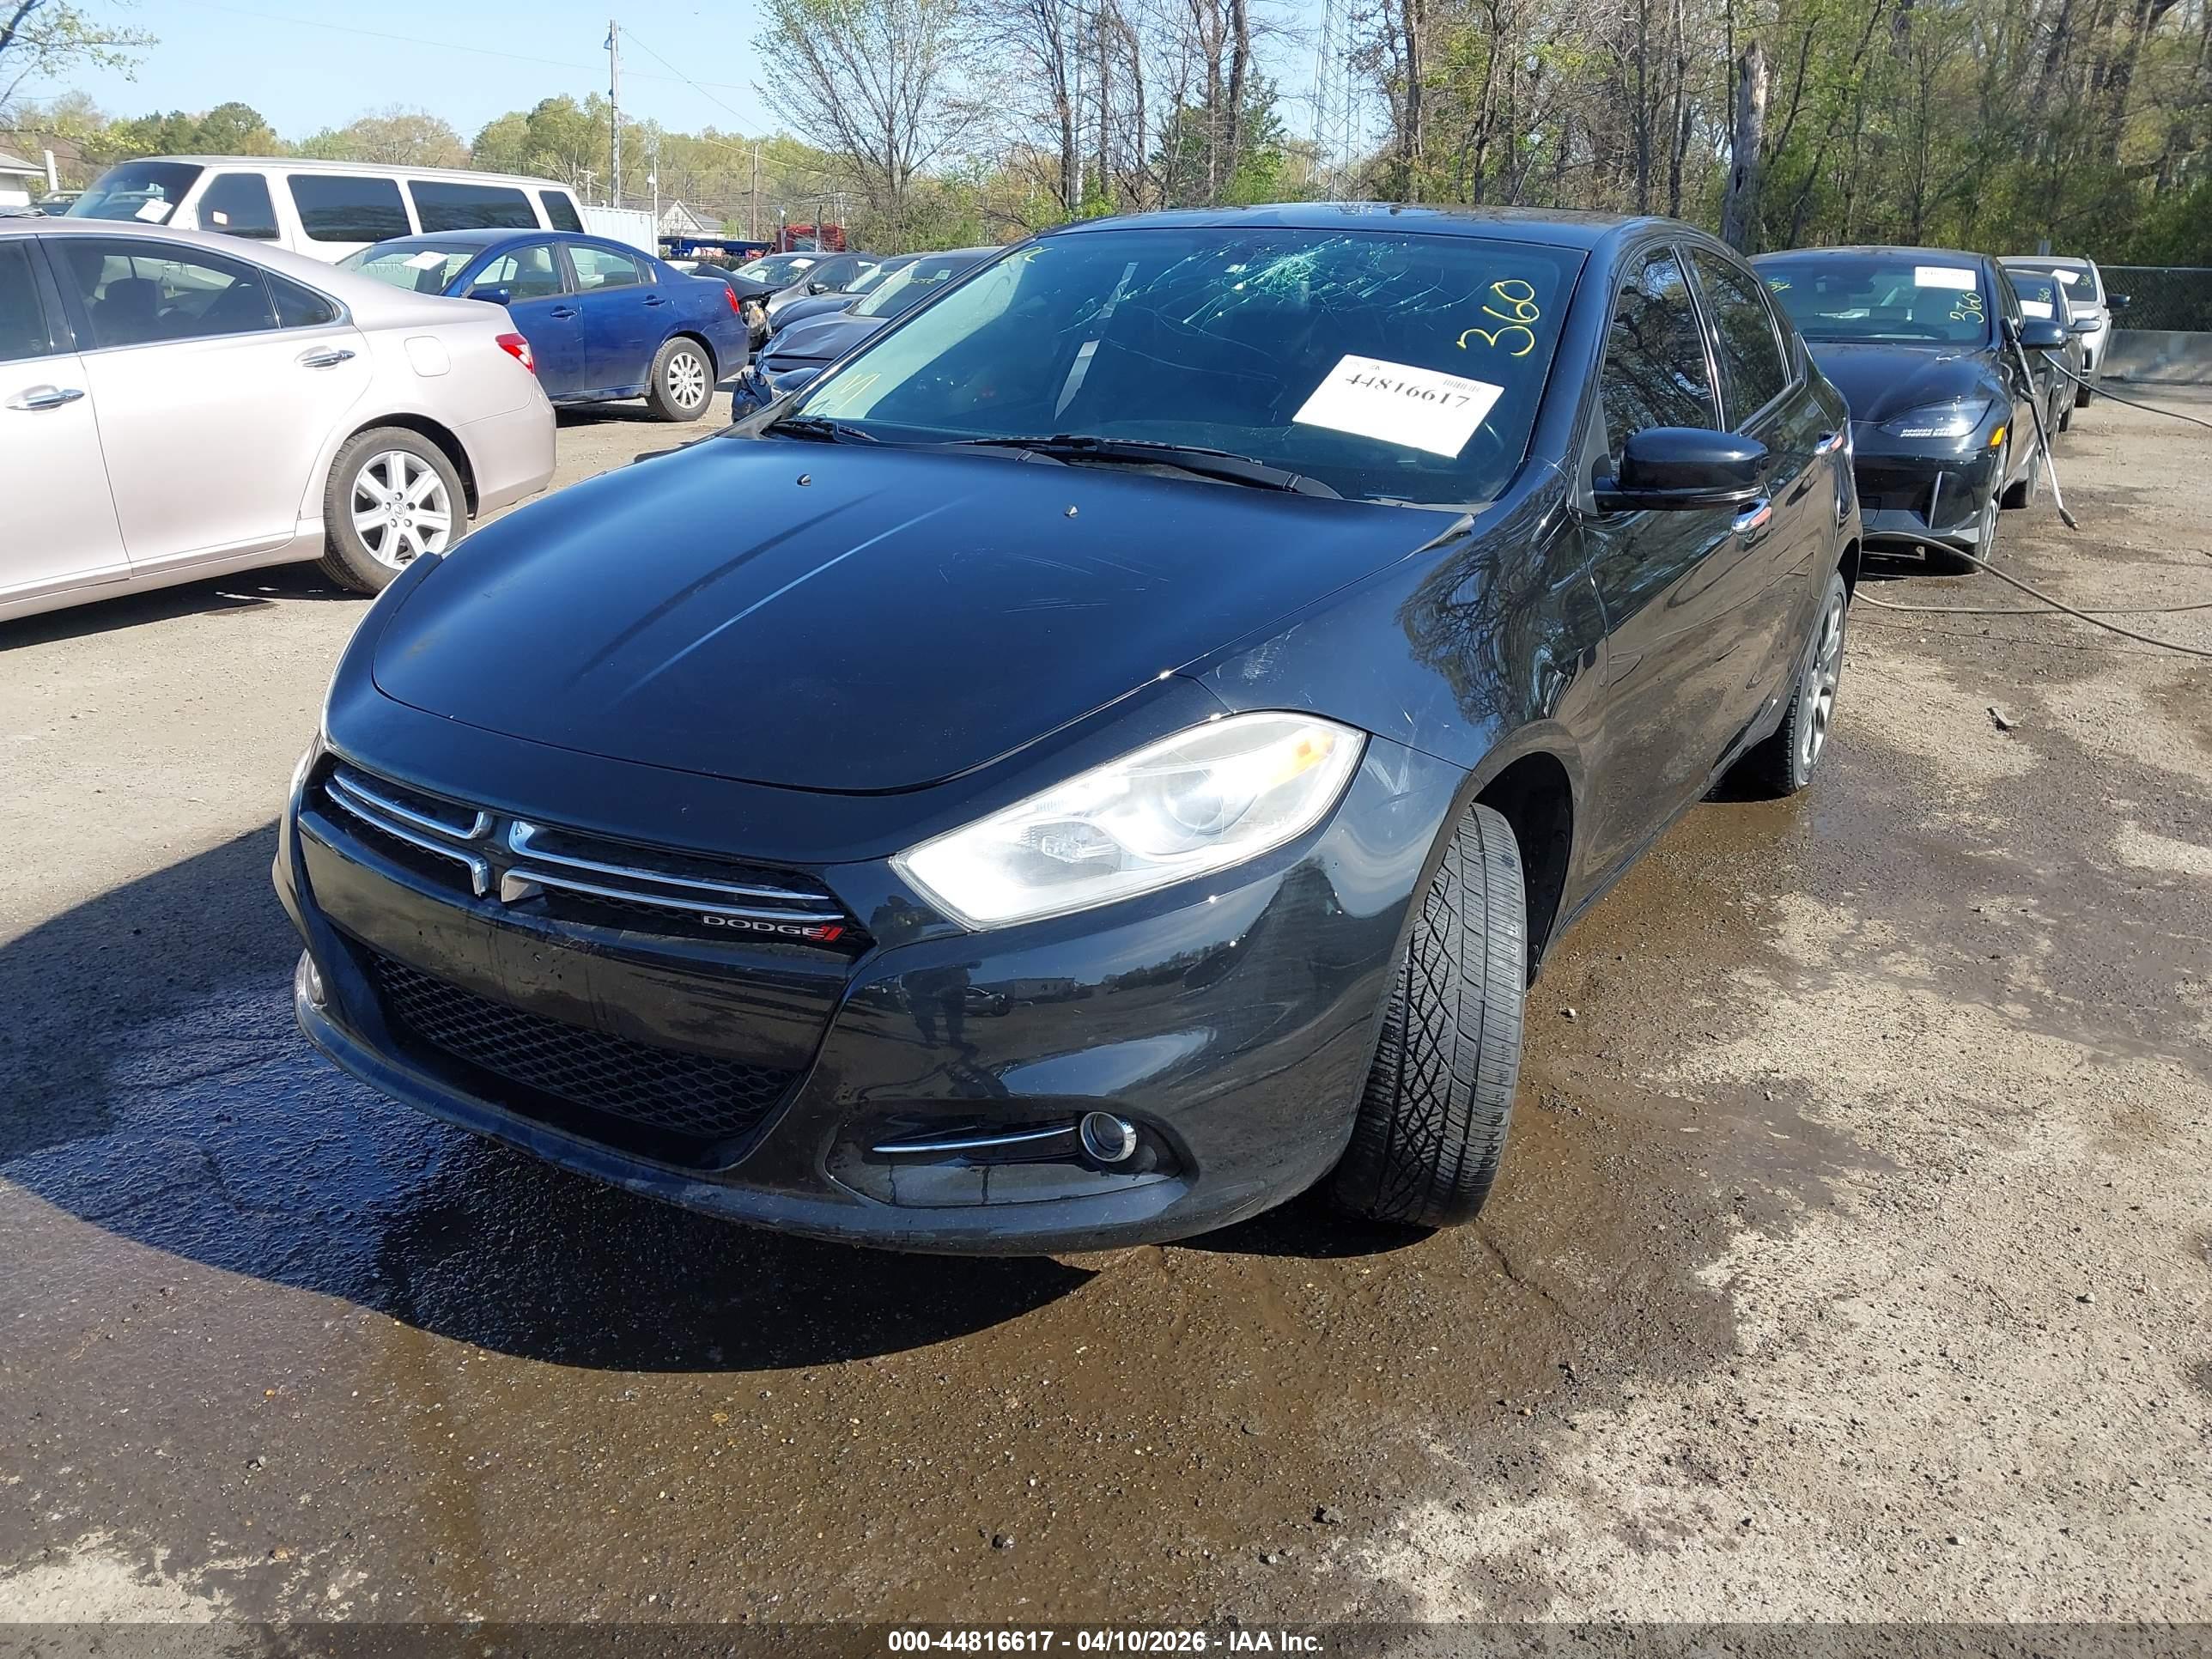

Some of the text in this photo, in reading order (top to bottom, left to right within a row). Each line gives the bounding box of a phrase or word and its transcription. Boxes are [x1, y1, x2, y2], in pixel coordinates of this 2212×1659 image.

[1456, 279, 1540, 356] 360
[1949, 292, 1984, 323] 360
[1346, 374, 1471, 409] 44816617
[702, 915, 825, 938] DODGE
